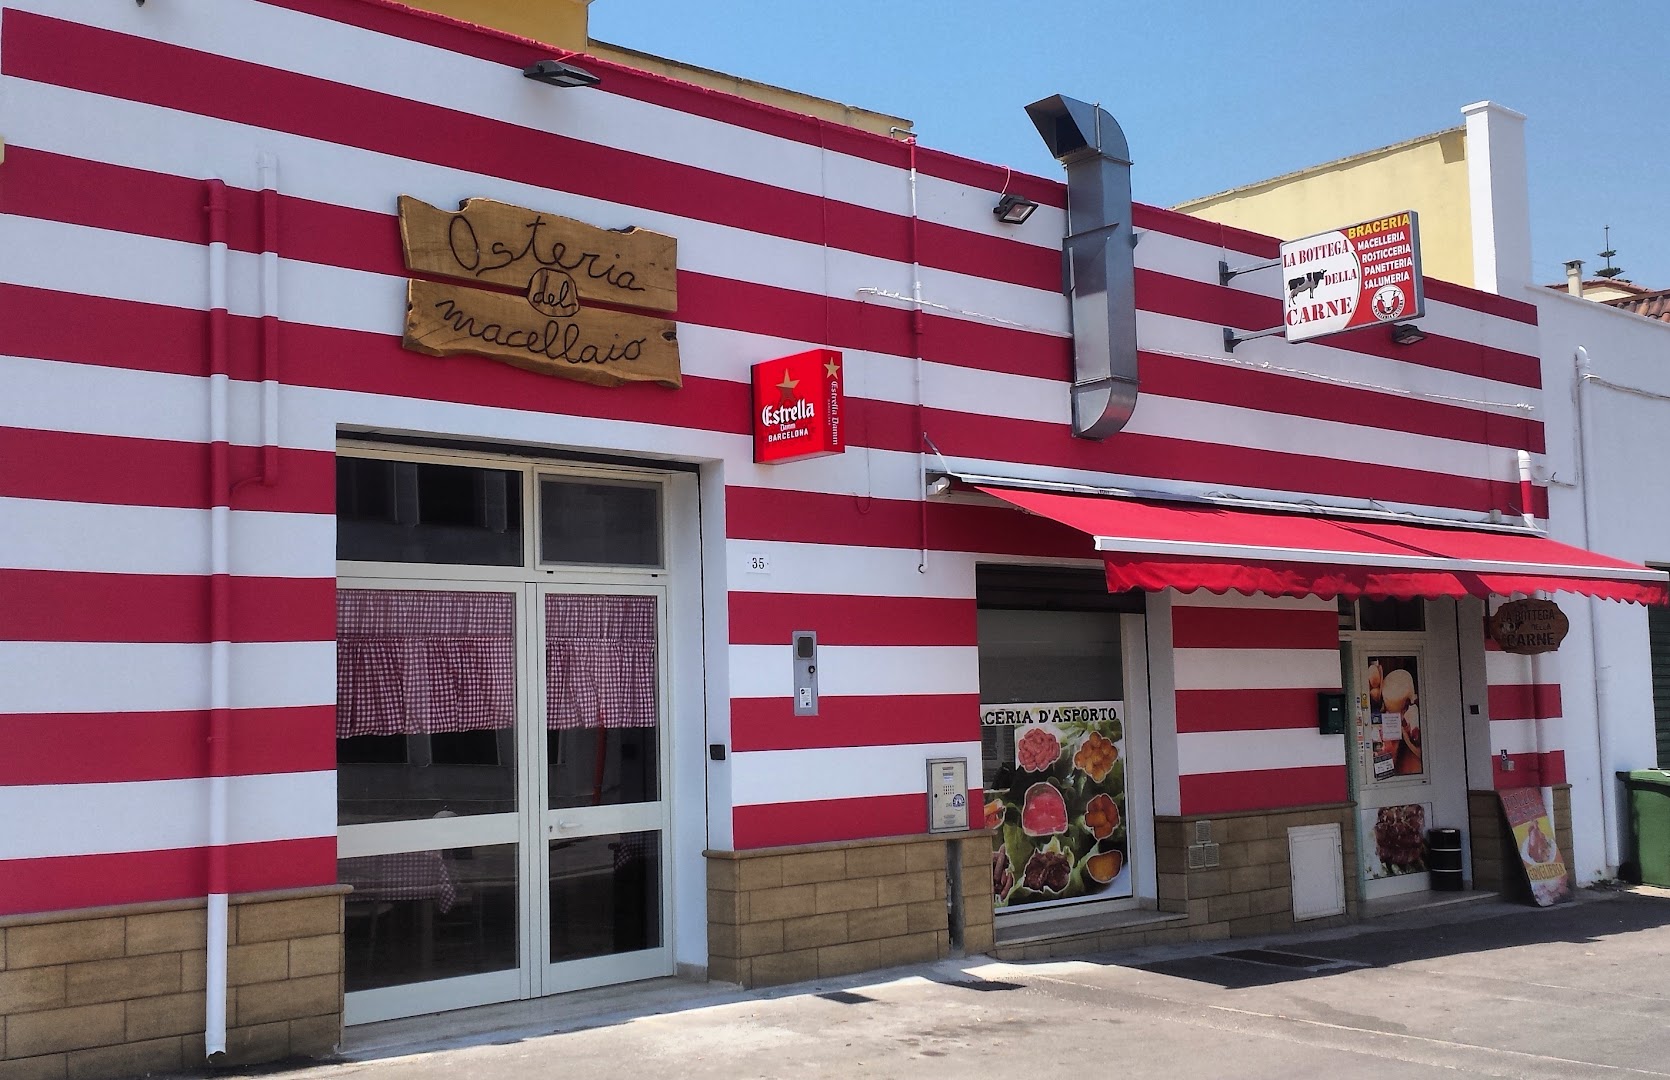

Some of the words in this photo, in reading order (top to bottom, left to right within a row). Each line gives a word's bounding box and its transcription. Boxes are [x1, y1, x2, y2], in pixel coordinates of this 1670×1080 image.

[1348, 214, 1410, 239] BRACERIA
[1357, 231, 1405, 251] MACELLERIA
[449, 215, 645, 291] Osteria
[1283, 251, 1297, 269] LA
[1299, 240, 1349, 264] BOTTEGA
[1362, 244, 1411, 263] ROSTICCERIA
[1364, 257, 1413, 276] PANETTERIA
[1325, 269, 1357, 286] DELLA
[1364, 271, 1410, 289] SALUMERIA
[532, 280, 577, 308] del
[1286, 297, 1352, 326] CARNE
[435, 300, 647, 364] macellaio
[762, 399, 815, 426] Estrella
[768, 428, 808, 442] BARCELONA
[780, 423, 796, 432] Damm
[751, 557, 765, 569] 35
[1515, 609, 1555, 621] BOTTEGA
[1507, 633, 1555, 646] CARNE
[1038, 707, 1117, 724] D'ASPORTO
